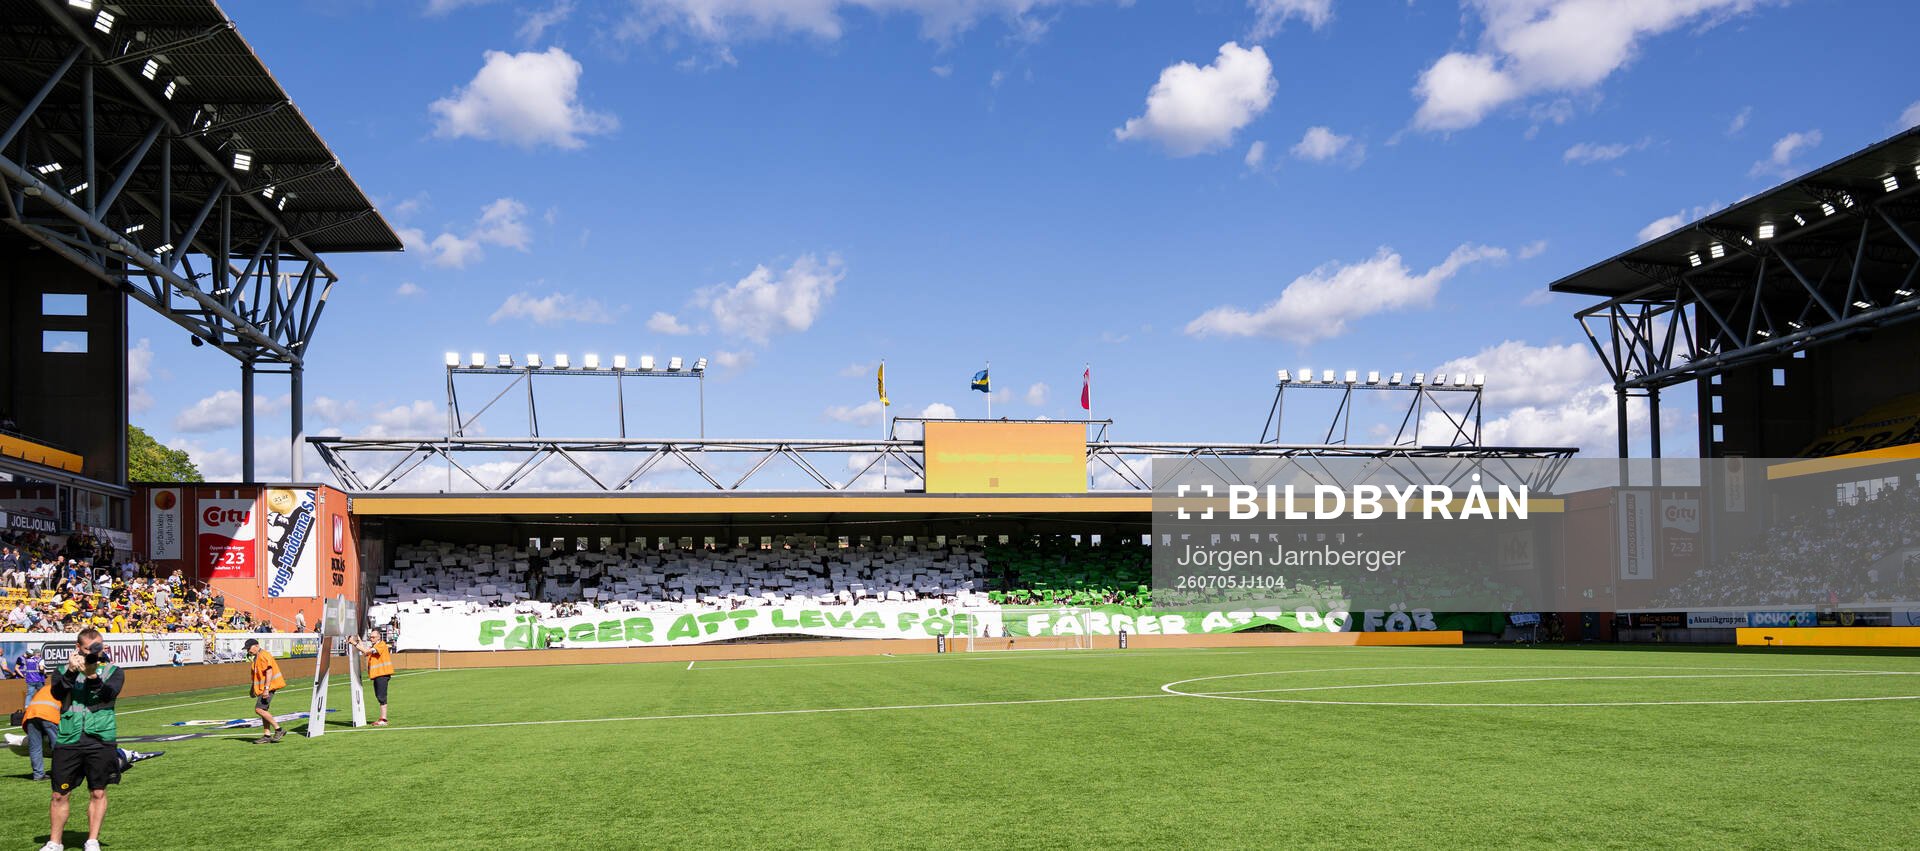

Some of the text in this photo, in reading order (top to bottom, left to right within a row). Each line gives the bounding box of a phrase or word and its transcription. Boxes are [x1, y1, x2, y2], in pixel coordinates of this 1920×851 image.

[203, 506, 250, 527] City
[1665, 505, 1696, 521] City
[11, 515, 57, 533] JOELJOLINA
[1670, 542, 1694, 552] 7-23
[209, 552, 245, 565] 7-23
[478, 600, 1440, 649] FÄRGER ATT LEVA FÖR FÄRGER ATT DÖ FÖR
[1693, 616, 1747, 625] Akustikgruppen
